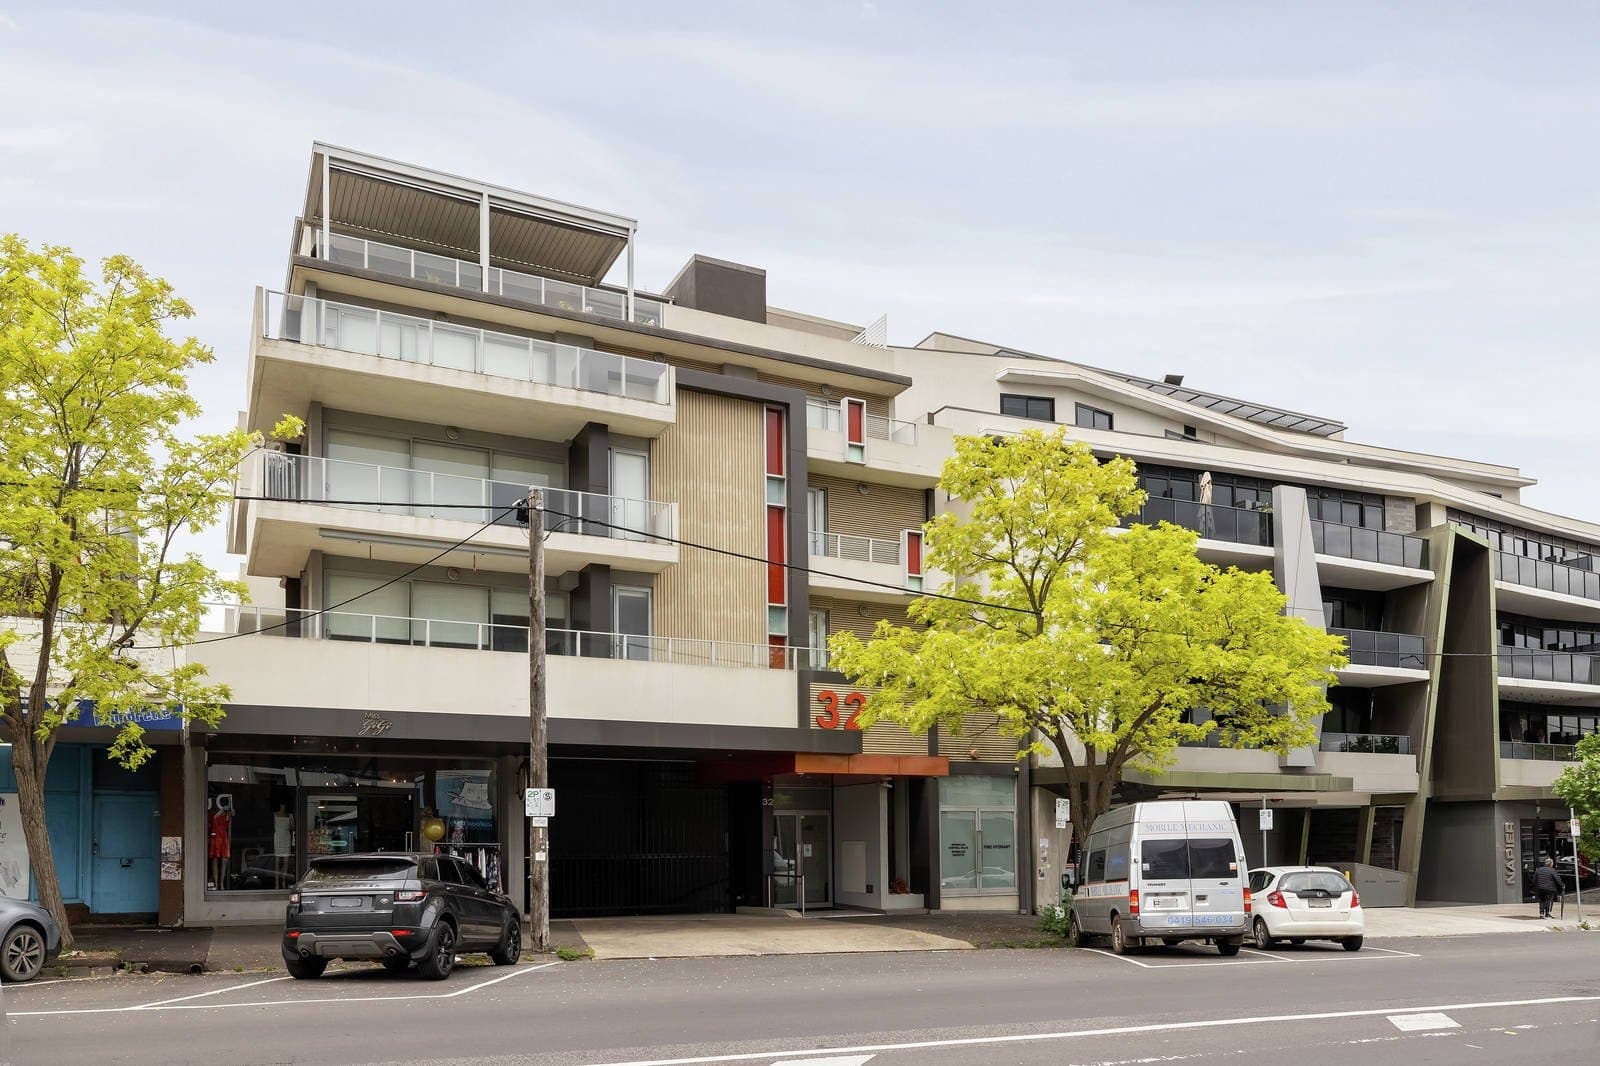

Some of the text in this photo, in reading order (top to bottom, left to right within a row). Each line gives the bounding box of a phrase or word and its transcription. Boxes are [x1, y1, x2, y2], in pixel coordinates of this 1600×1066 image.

[816, 690, 867, 731] 32
[527, 790, 539, 798] 2P
[761, 798, 774, 806] 32
[1144, 823, 1178, 832] MOBILE
[1504, 822, 1516, 885] NAPIER
[1167, 915, 1233, 925] 0419 546 034
